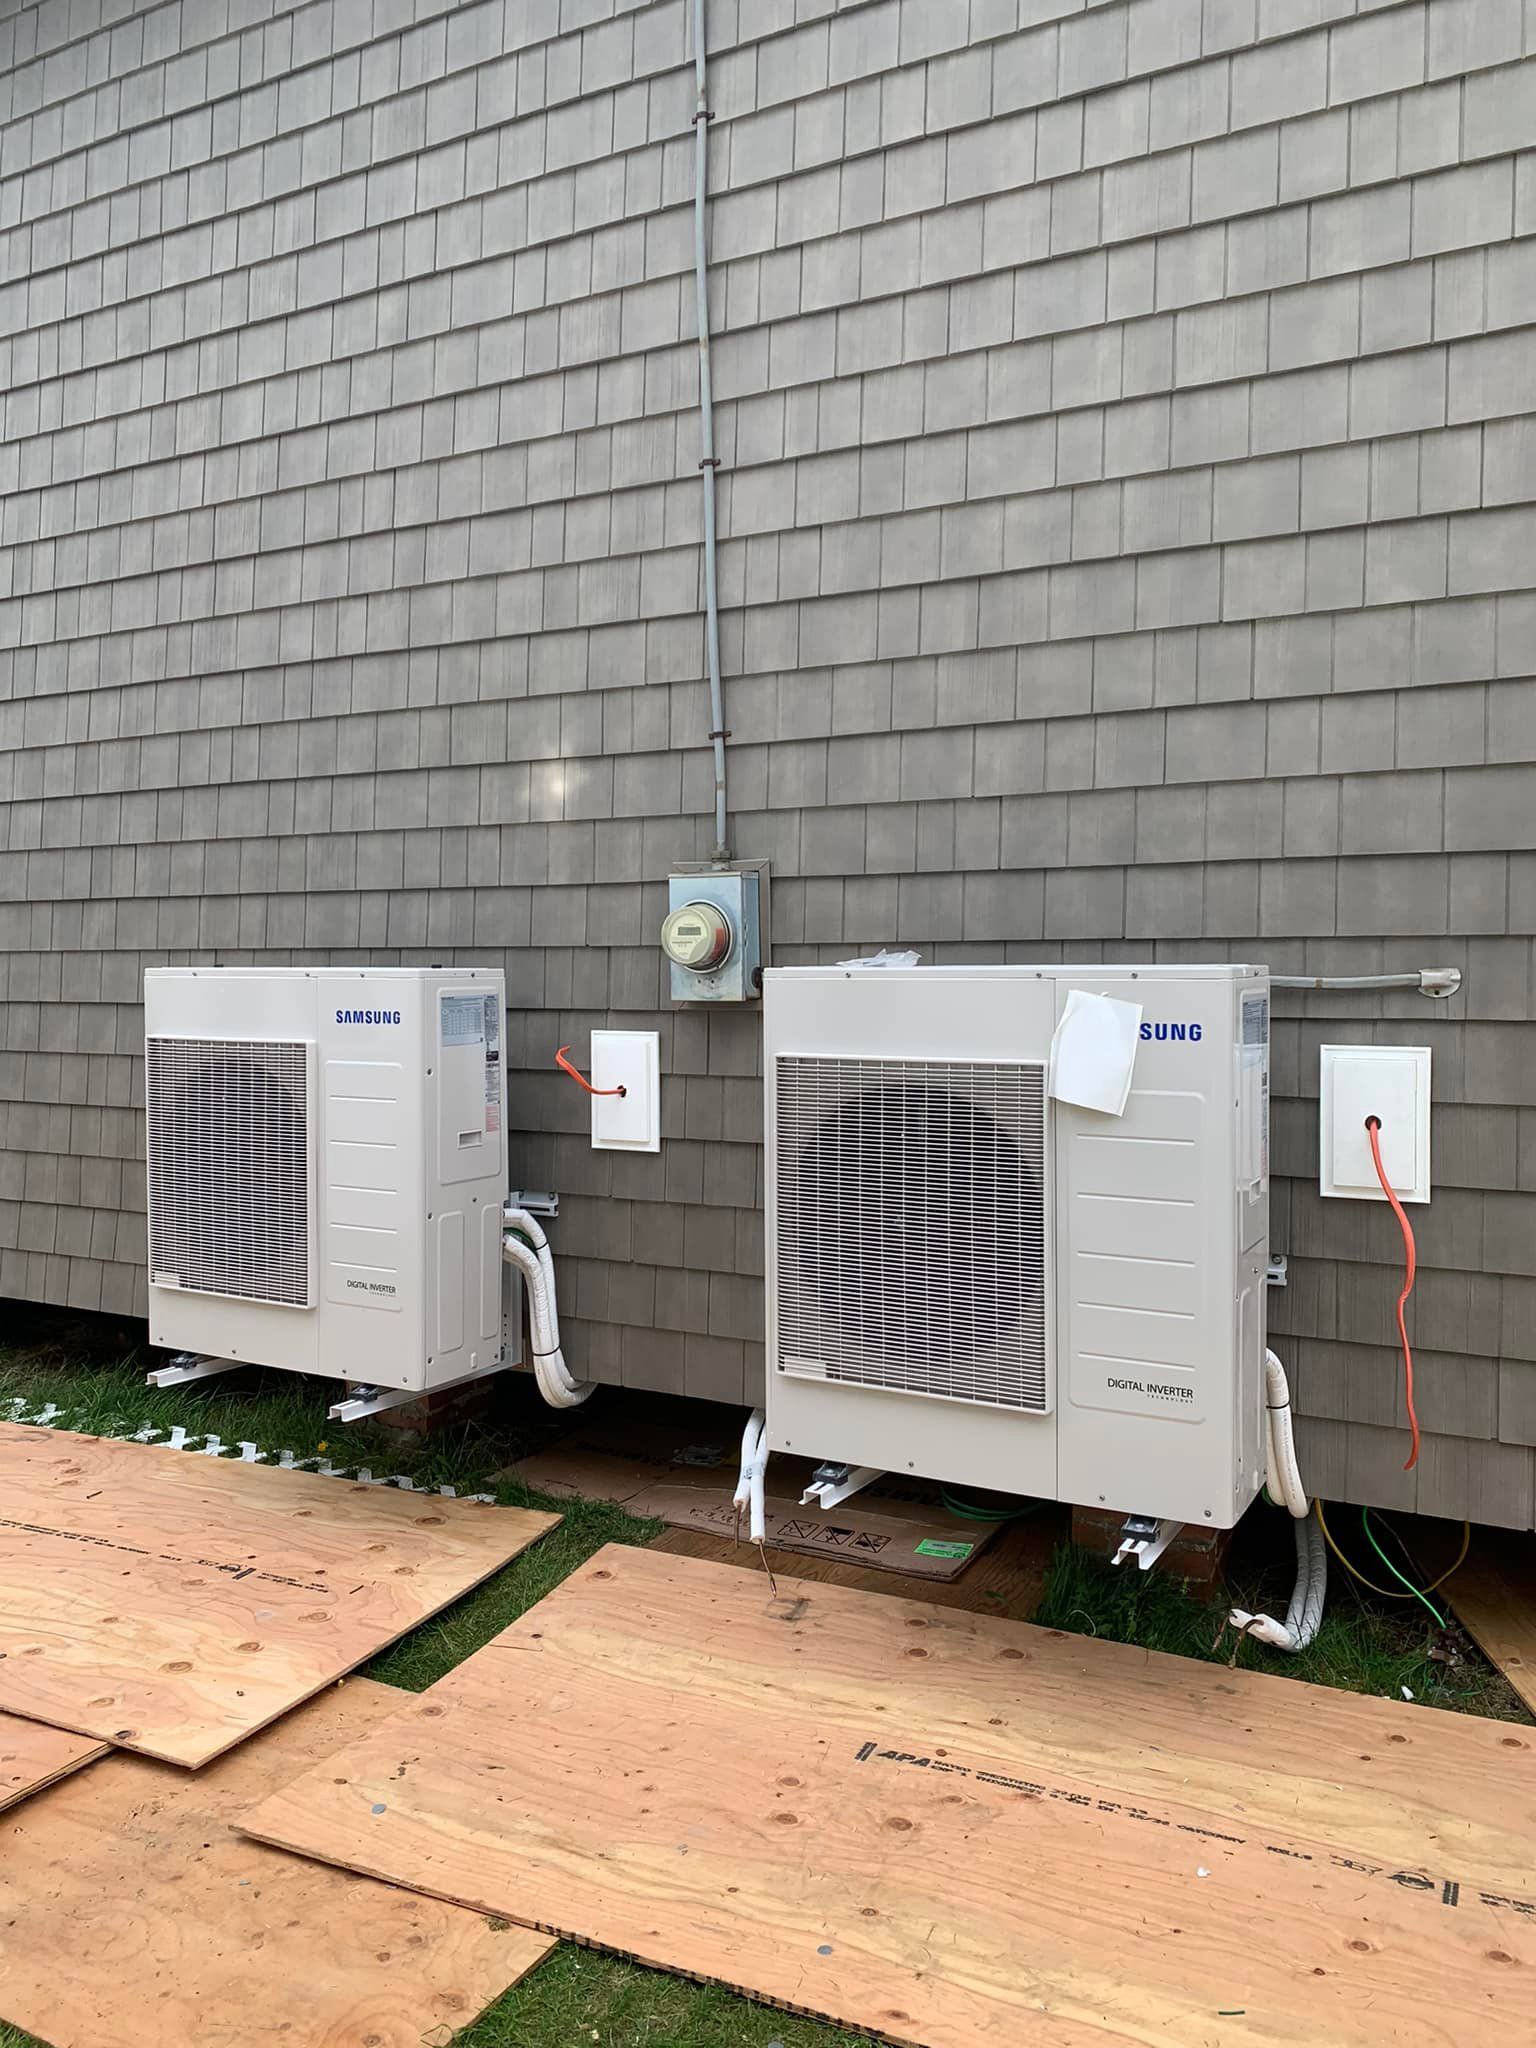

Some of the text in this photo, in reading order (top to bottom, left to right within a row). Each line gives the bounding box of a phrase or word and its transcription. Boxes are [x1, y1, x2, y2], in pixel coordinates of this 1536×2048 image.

[335, 1010, 401, 1025] SAMSUNG
[1139, 1022, 1202, 1041] SUNG
[1107, 1378, 1144, 1392] DIGITAL
[1147, 1383, 1194, 1399] INVERTER
[876, 1750, 931, 1768] APA
